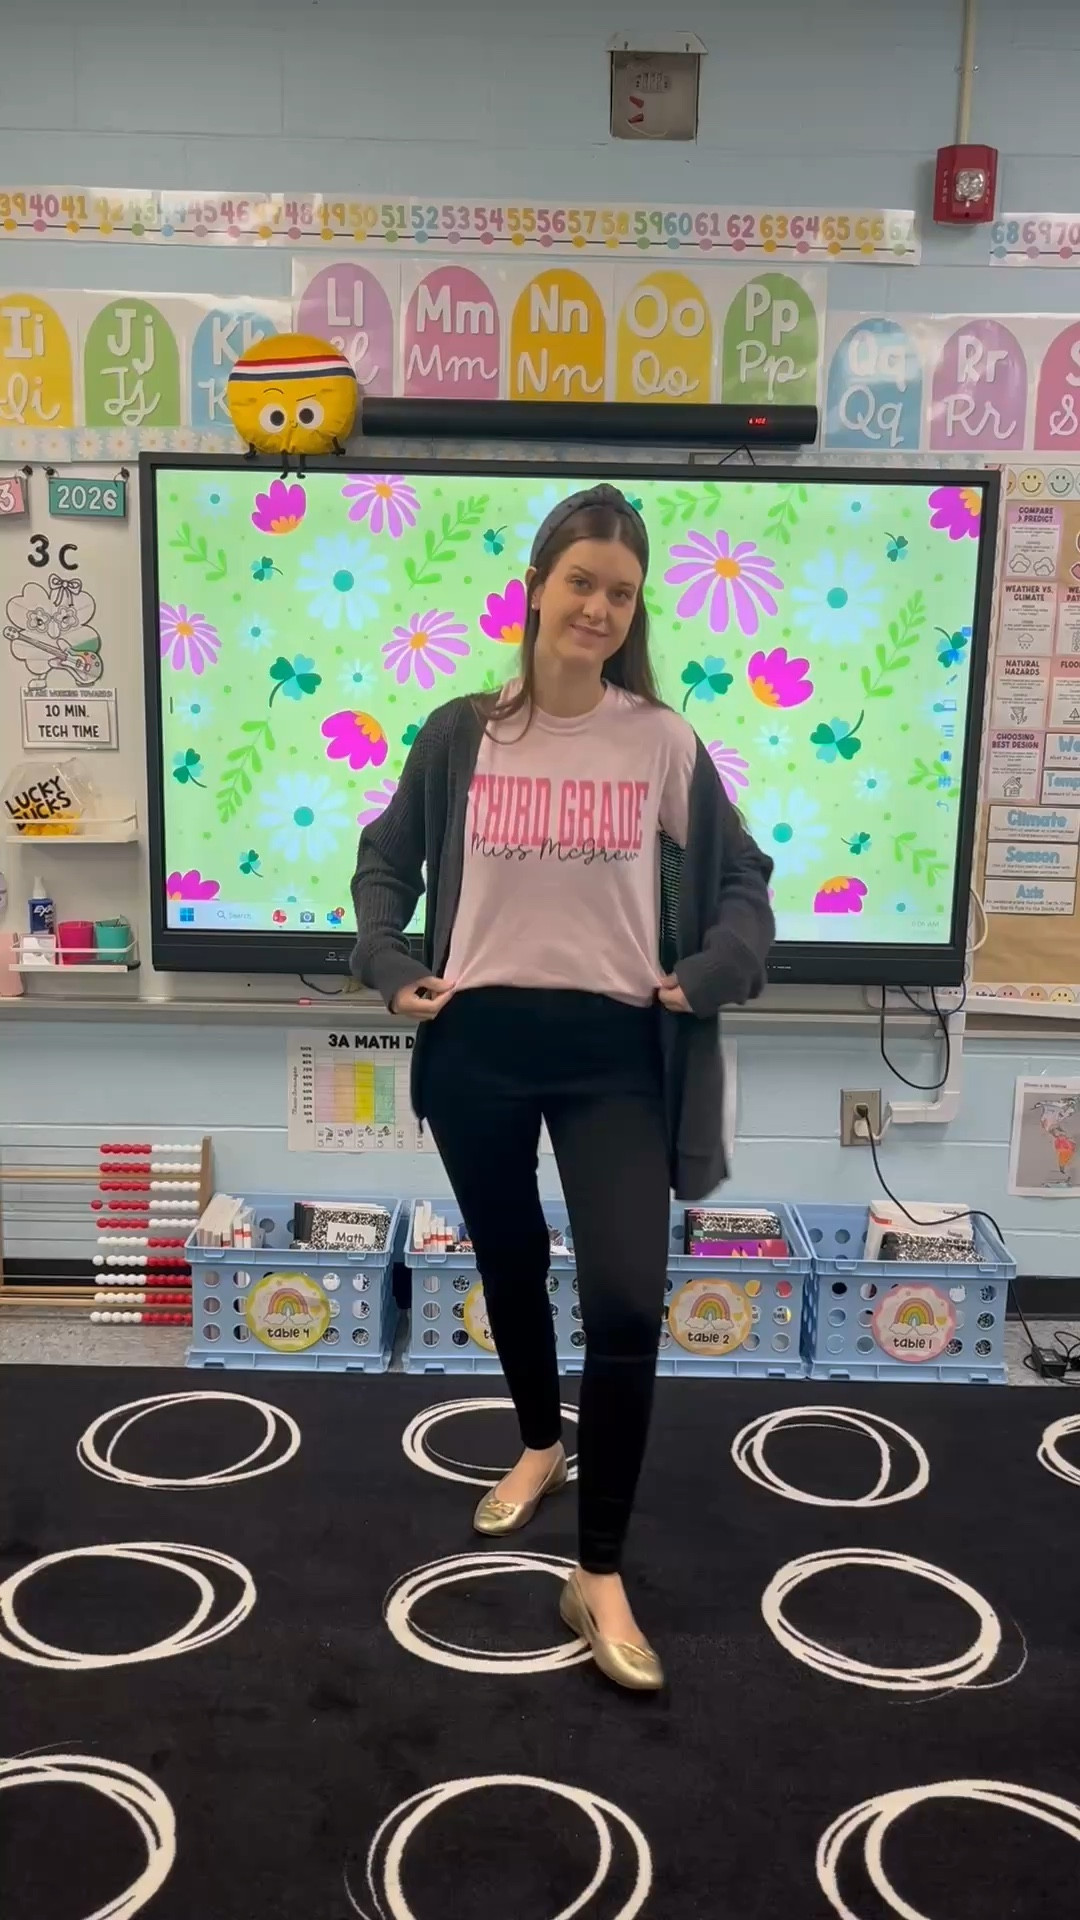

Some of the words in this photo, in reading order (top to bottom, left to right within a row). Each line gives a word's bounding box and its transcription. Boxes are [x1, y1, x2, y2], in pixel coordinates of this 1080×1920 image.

[30, 194, 59, 217] 40
[61, 195, 88, 219] 41
[188, 200, 218, 223] 45
[285, 201, 313, 225] 48
[317, 203, 345, 227] 49
[350, 204, 378, 228] 50
[381, 205, 407, 228] 51
[411, 205, 439, 229] 52
[441, 206, 470, 230] 53
[474, 207, 503, 232] 54
[507, 208, 536, 232] 55
[537, 209, 566, 233] 56
[568, 210, 596, 235] 57
[601, 211, 629, 236] 58
[633, 211, 662, 235] 59
[664, 212, 692, 236] 60
[695, 212, 720, 236] 61
[727, 214, 755, 238] 62
[759, 214, 789, 239] 63
[790, 215, 820, 240] 64
[822, 216, 850, 240] 65
[854, 217, 885, 241] 66
[991, 221, 1020, 244] 68
[1022, 221, 1052, 244] 69
[416, 284, 494, 334] Mm
[530, 284, 589, 333] Nn
[626, 285, 705, 338] Oo
[746, 284, 799, 346] Pp
[107, 308, 155, 376] Jj
[957, 335, 1009, 383] Rr
[406, 344, 498, 382] Mm
[517, 348, 604, 396] Nn
[632, 350, 699, 397] Oo
[736, 340, 807, 400] Pp
[848, 330, 909, 392] Qq
[840, 385, 905, 448] Qq
[944, 394, 1017, 440] Rr
[57, 485, 118, 510] 2026
[1006, 585, 1040, 593] WEATHER
[1005, 668, 1040, 676] HAZARDS
[45, 705, 60, 717] 10
[65, 705, 90, 718] MIN.
[38, 725, 68, 738] TECH
[73, 725, 99, 738] TIME
[5, 776, 61, 815] LUCKY
[470, 774, 551, 846] THIRD
[558, 779, 650, 850] GRADE
[1007, 810, 1067, 828] Climate
[471, 832, 532, 861] Miss
[540, 836, 640, 865] McGrew
[1006, 846, 1060, 863] Season
[1016, 884, 1044, 899] Axis
[229, 912, 251, 920] Search
[328, 1033, 350, 1048] 3A
[355, 1034, 400, 1049] MATH
[335, 1231, 365, 1245] Math
[267, 1327, 300, 1338] table
[303, 1328, 309, 1338] 4
[688, 1331, 720, 1343] table
[723, 1334, 730, 1344] 2
[893, 1337, 926, 1349] table
[929, 1339, 932, 1349] 1
